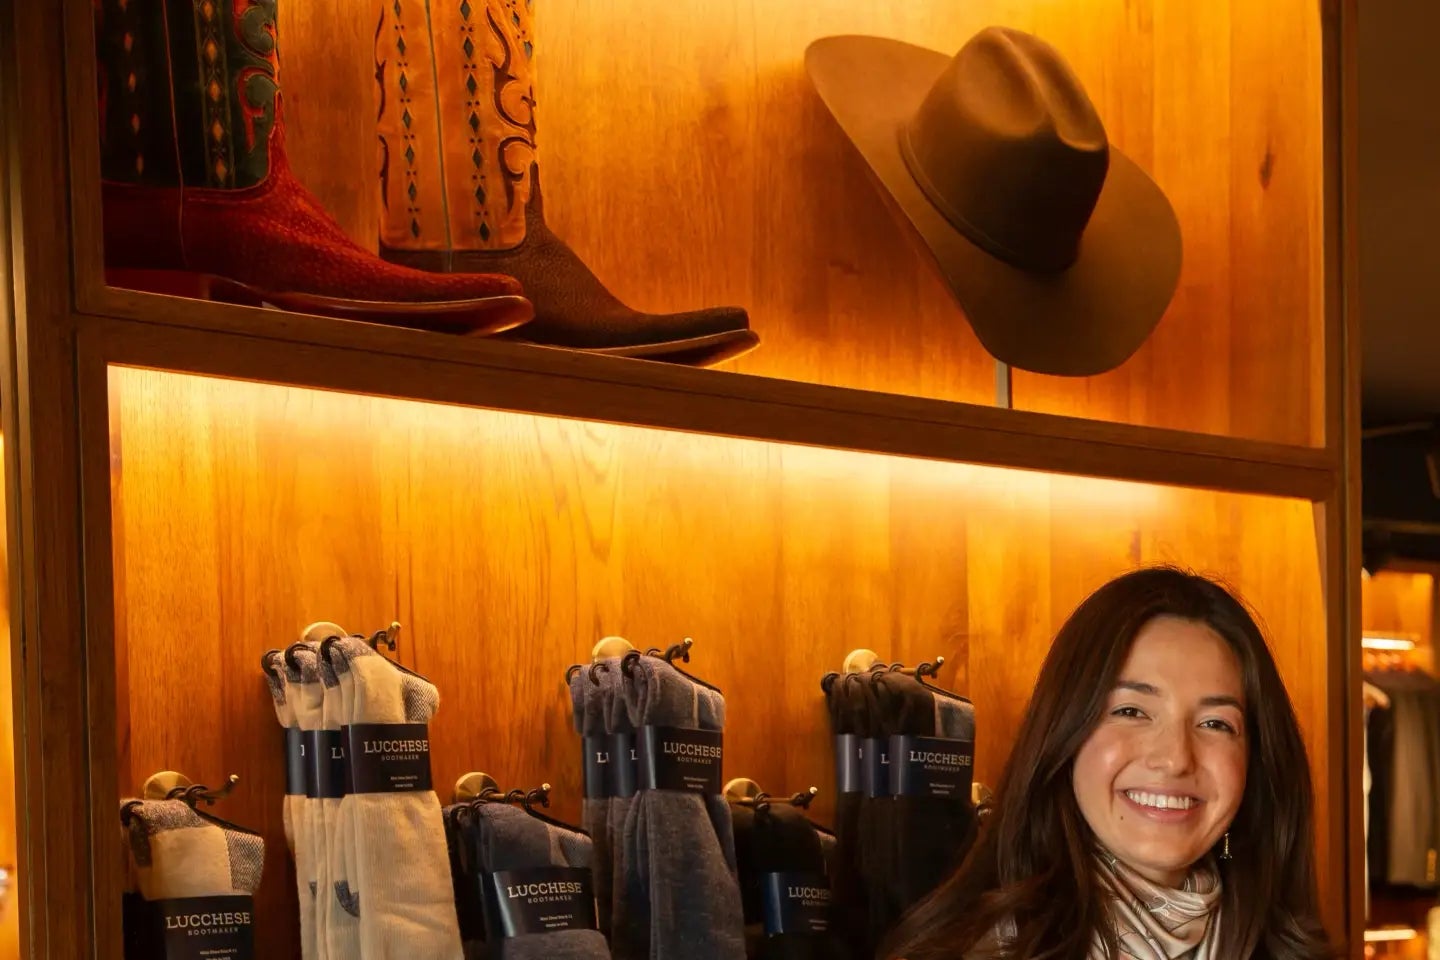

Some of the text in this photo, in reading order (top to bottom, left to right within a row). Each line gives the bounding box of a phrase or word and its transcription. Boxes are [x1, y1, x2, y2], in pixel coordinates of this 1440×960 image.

[363, 740, 429, 753] LUCCHESE
[663, 741, 722, 758] LUCCHESE
[909, 750, 972, 766] LUCCHESE
[507, 881, 583, 898] LUCCHESE
[165, 912, 251, 929] LUCCHESE
[187, 927, 239, 936] BOOTMAKER
